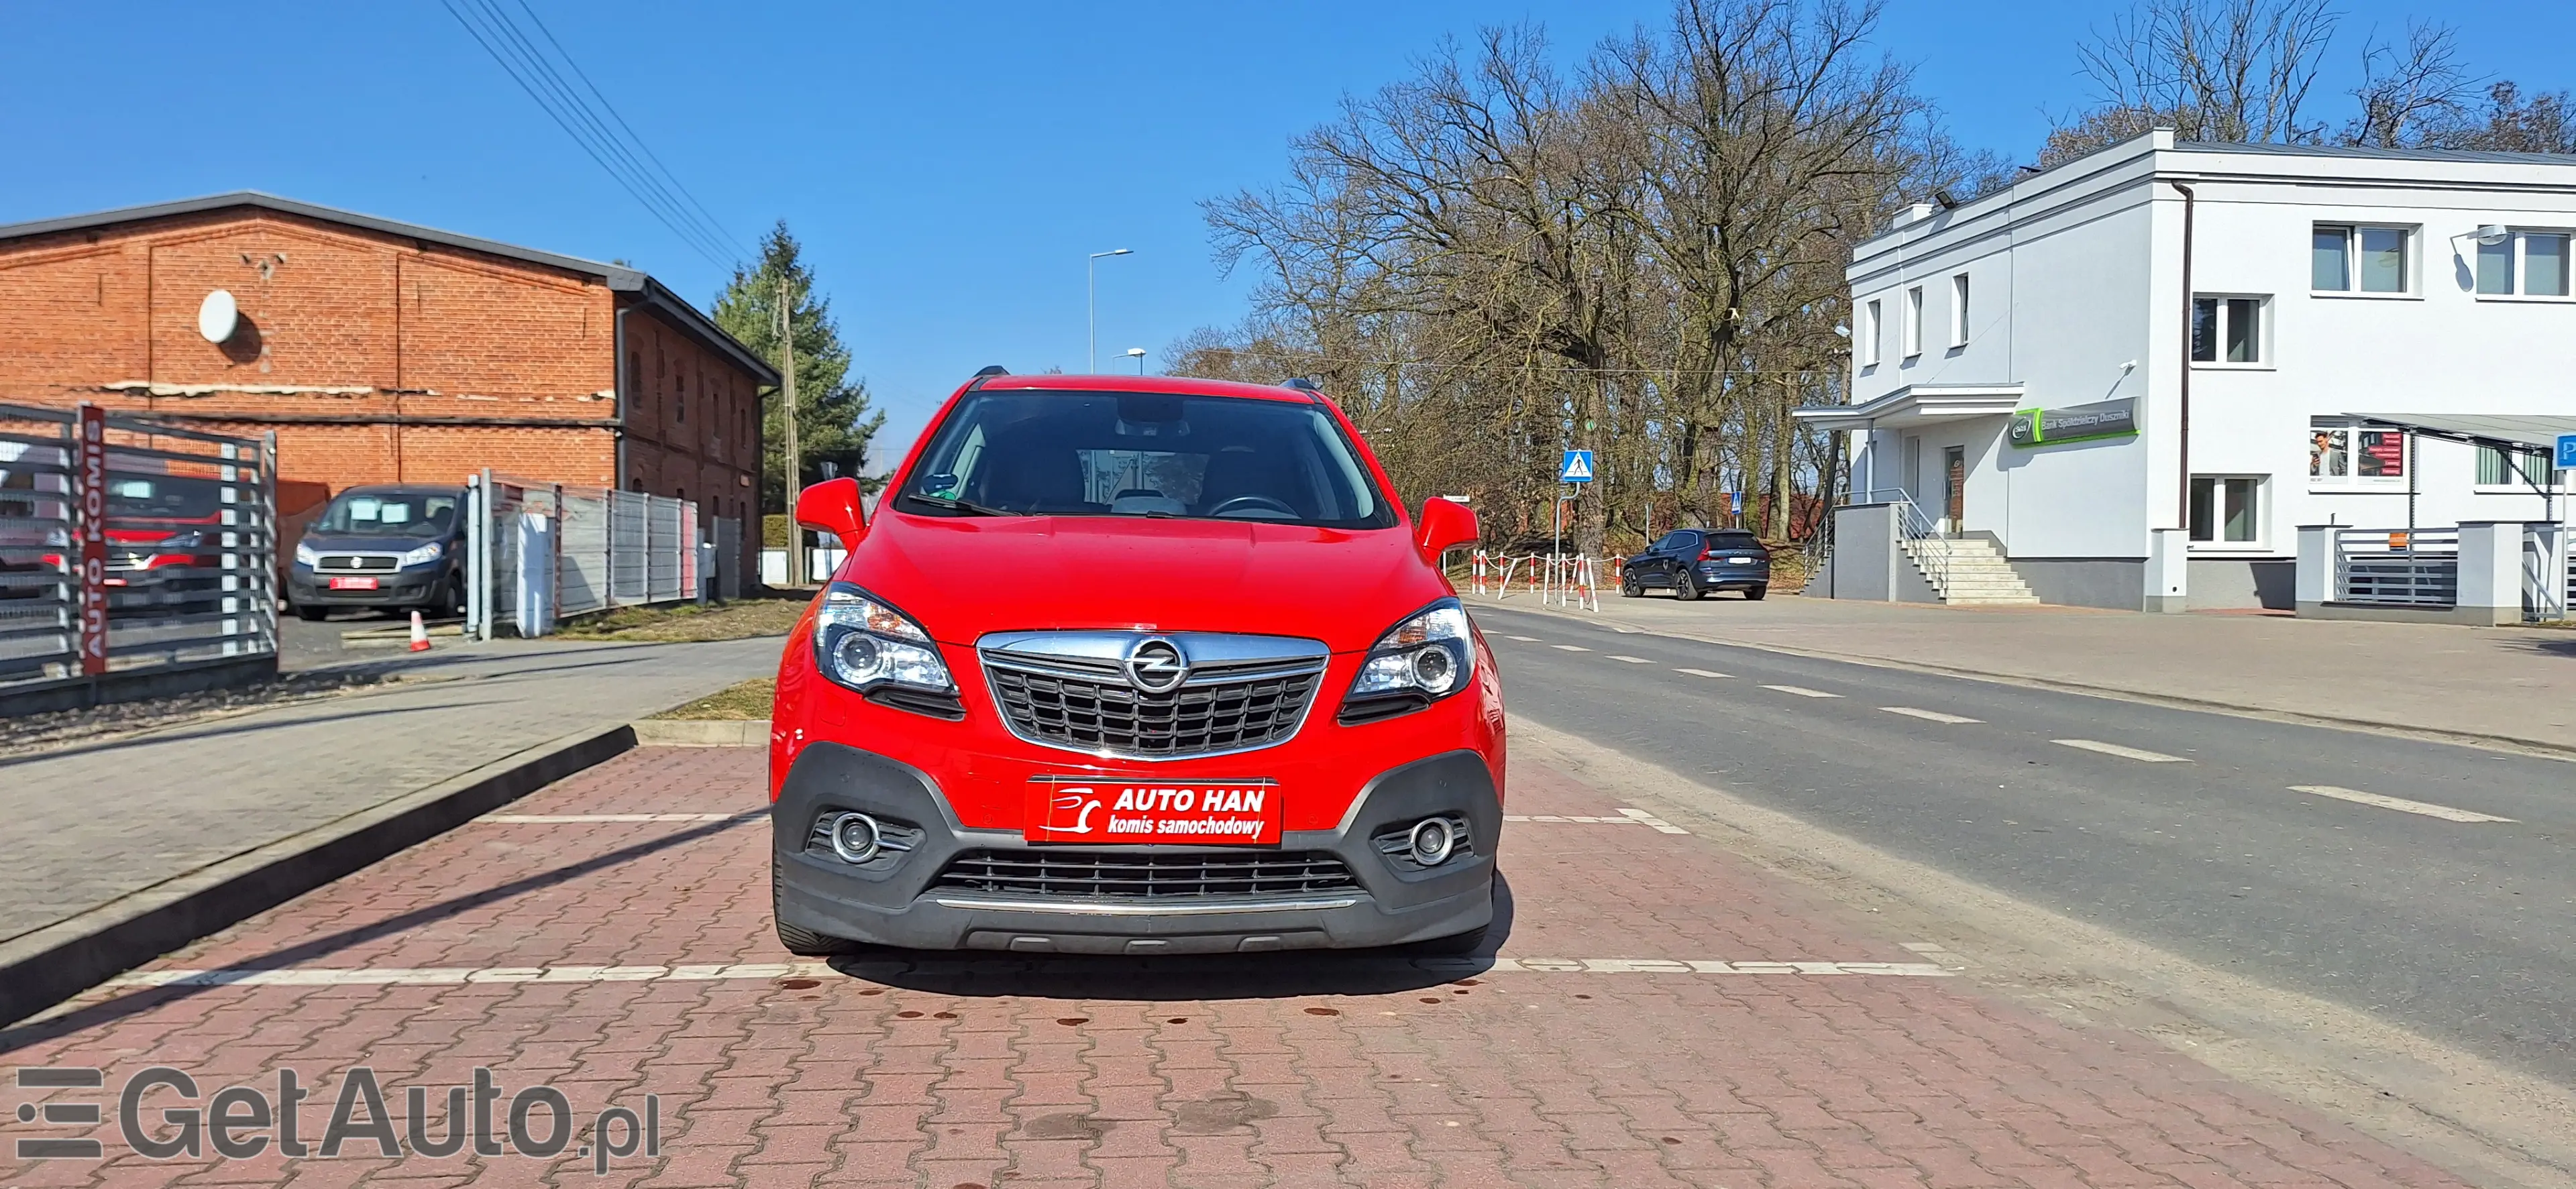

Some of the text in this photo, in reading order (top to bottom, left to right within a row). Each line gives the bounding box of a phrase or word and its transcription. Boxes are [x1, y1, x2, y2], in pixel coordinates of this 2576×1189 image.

[2042, 420, 2057, 431] Bank
[2563, 441, 2576, 460] P
[86, 419, 103, 659] AUTO KOMIS
[1113, 788, 1265, 812] AUTO HAN
[1108, 814, 1265, 840] komis samochodowy
